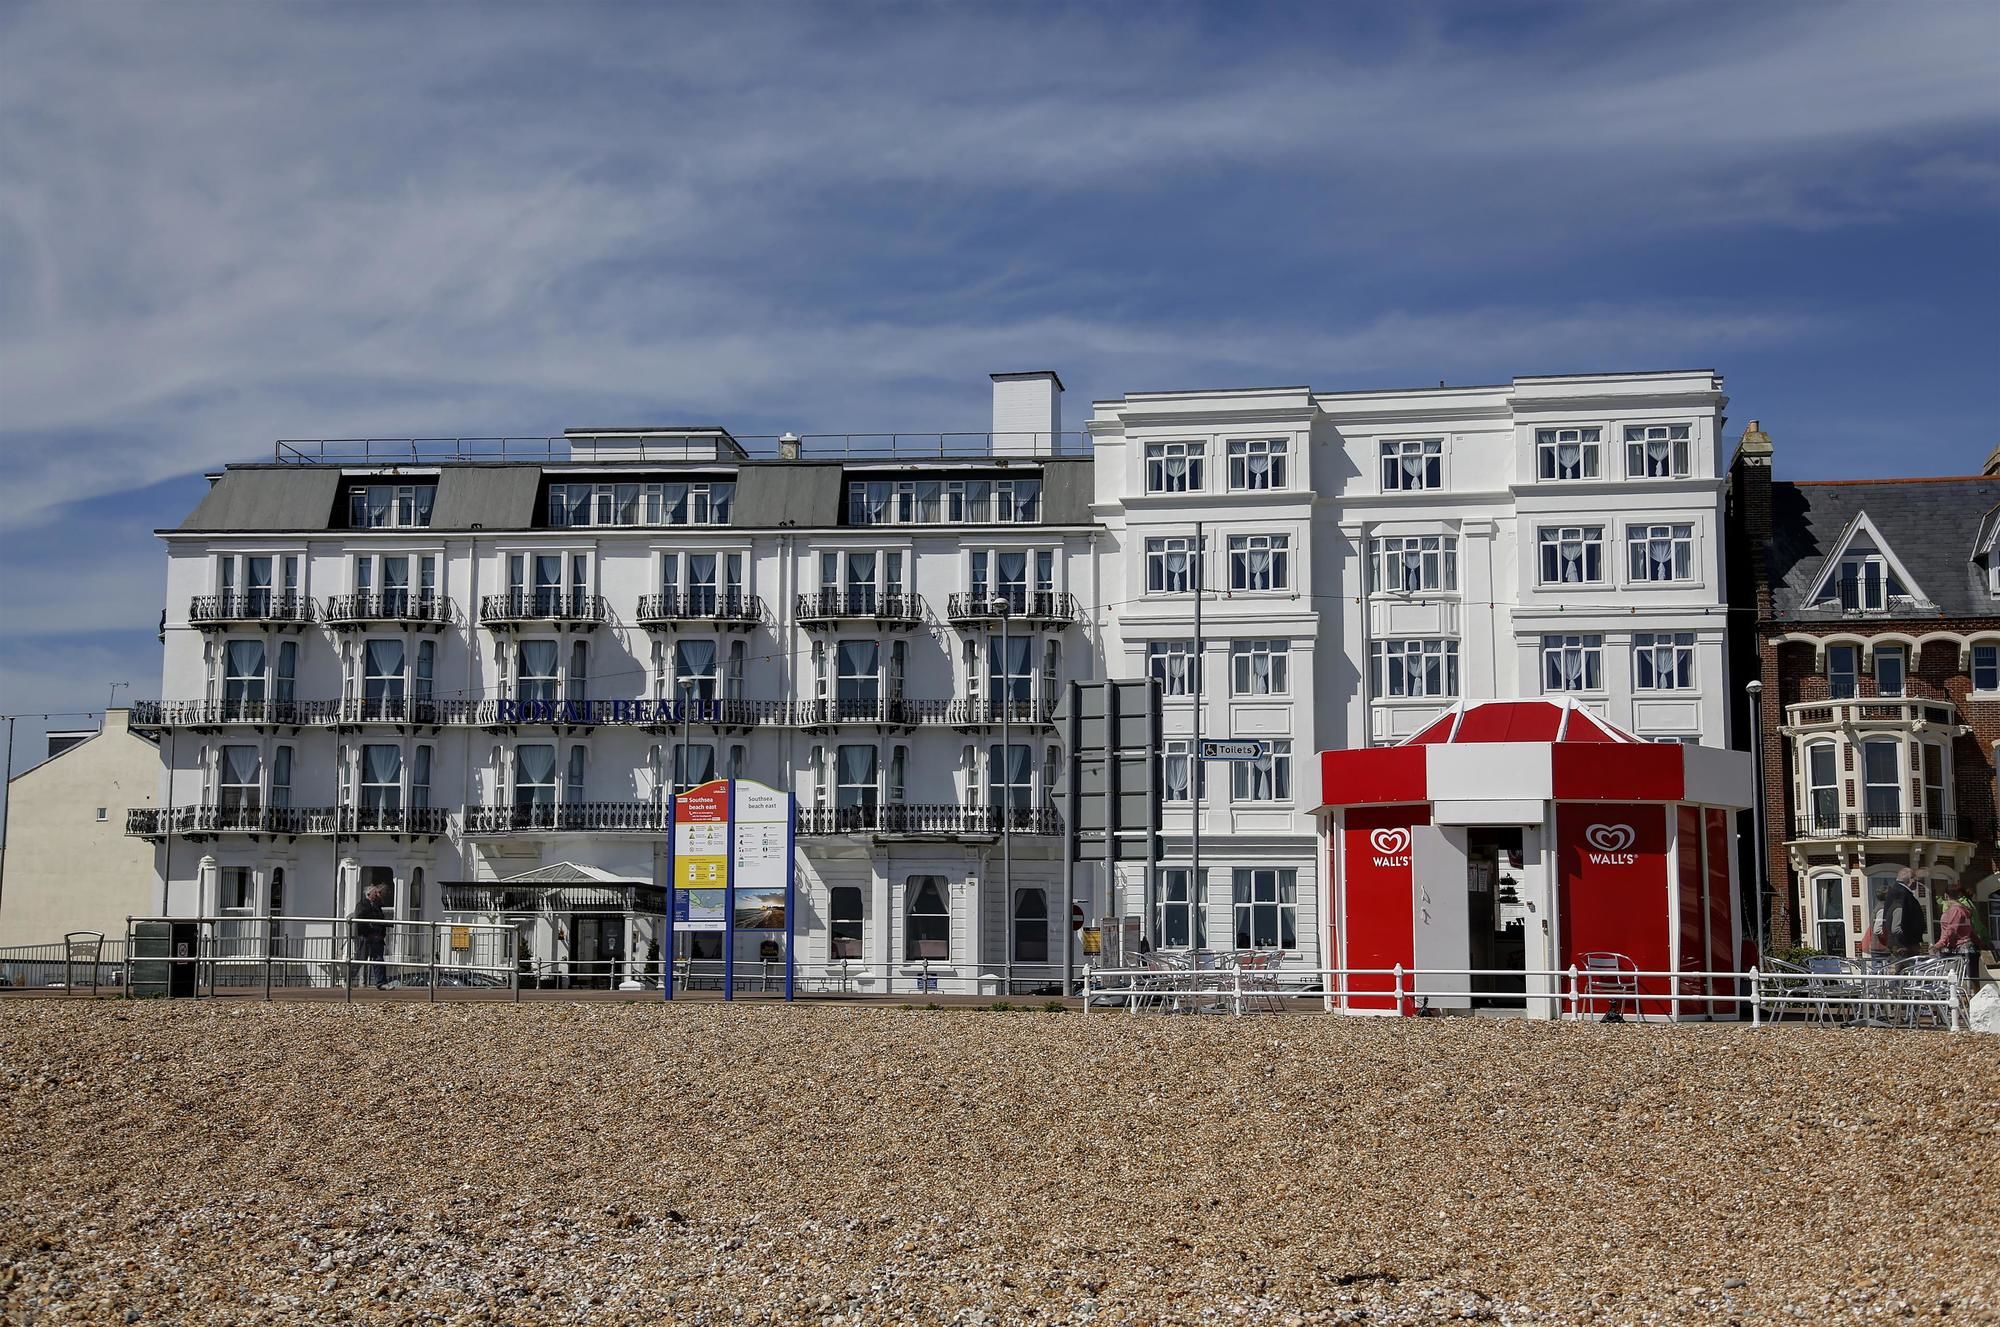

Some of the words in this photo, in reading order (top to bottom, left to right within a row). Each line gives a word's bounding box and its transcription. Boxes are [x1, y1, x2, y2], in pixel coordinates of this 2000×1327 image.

[497, 699, 601, 722] ROYAL
[611, 699, 722, 722] BEACH
[1220, 745, 1252, 754] Toilets
[1373, 856, 1409, 867] WALL'S
[1589, 854, 1634, 865] WALL'S
